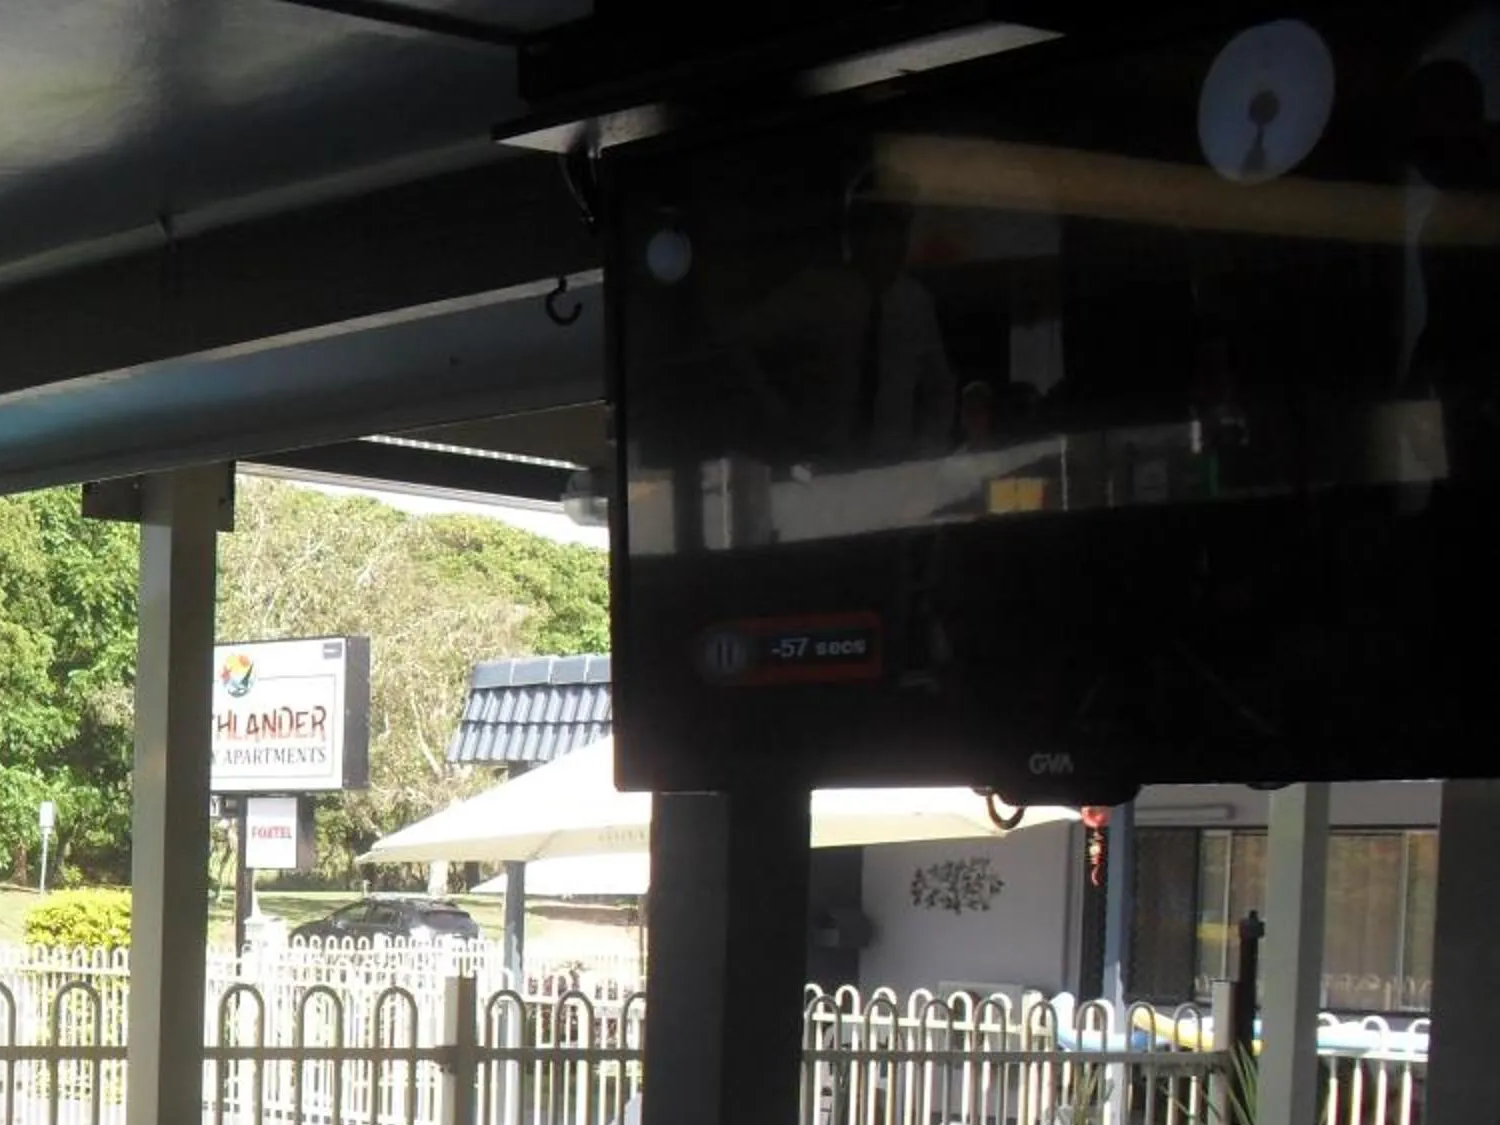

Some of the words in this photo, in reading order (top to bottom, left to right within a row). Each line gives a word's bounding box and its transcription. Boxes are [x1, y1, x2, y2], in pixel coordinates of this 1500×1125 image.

[770, 636, 810, 658] -57
[815, 638, 867, 656] secs
[212, 705, 327, 741] HLANDER
[223, 747, 327, 765] APARTMENTS
[1029, 752, 1074, 775] GVA
